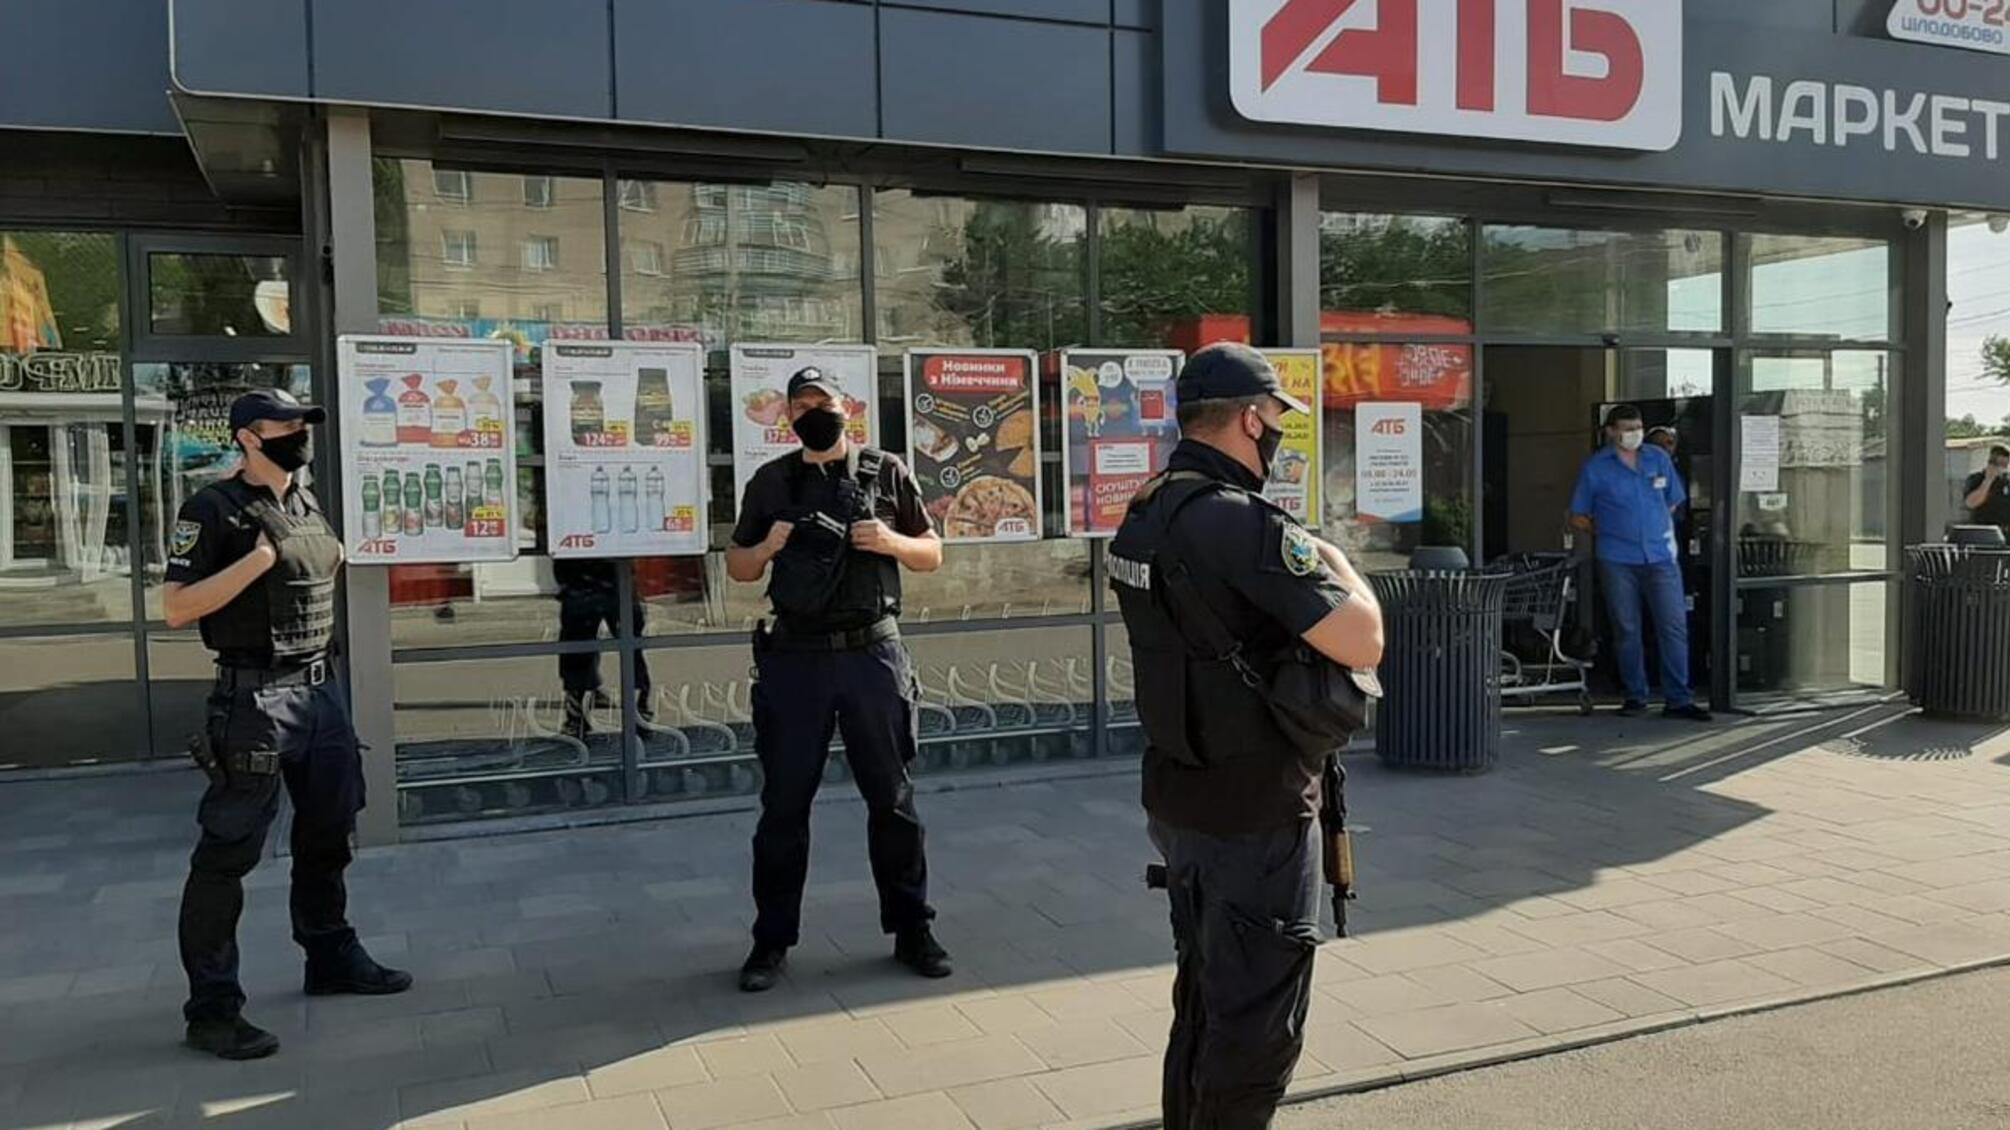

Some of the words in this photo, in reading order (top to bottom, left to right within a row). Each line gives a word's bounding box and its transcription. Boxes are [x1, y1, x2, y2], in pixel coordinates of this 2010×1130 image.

[1901, 16, 2003, 44] ЦІЛОДОБОВО
[1710, 71, 2010, 159] МАРКЕТ
[942, 360, 1005, 373] Новинки
[1371, 419, 1405, 434] АТБ
[1001, 521, 1025, 532] АТБ
[358, 540, 397, 554] АТБ
[559, 535, 595, 548] АТБ
